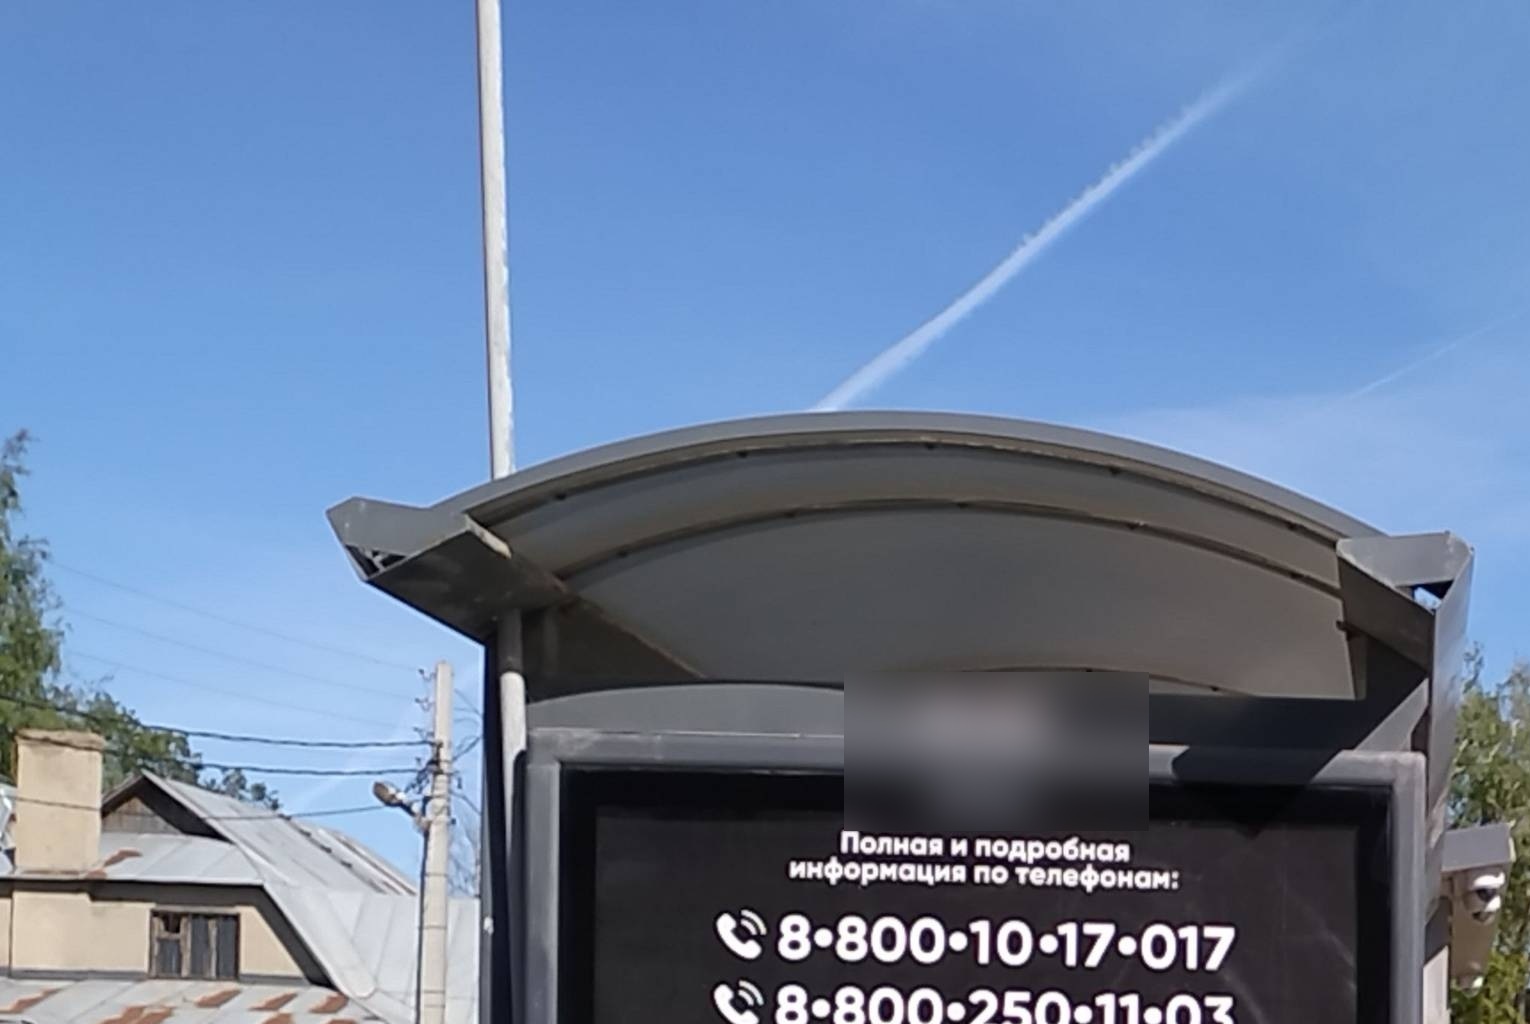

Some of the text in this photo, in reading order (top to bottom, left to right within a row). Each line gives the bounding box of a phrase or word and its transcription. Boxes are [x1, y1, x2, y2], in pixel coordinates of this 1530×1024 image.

[840, 830, 1130, 865] Полная и подробная
[789, 856, 1179, 893] информация по телефонам:
